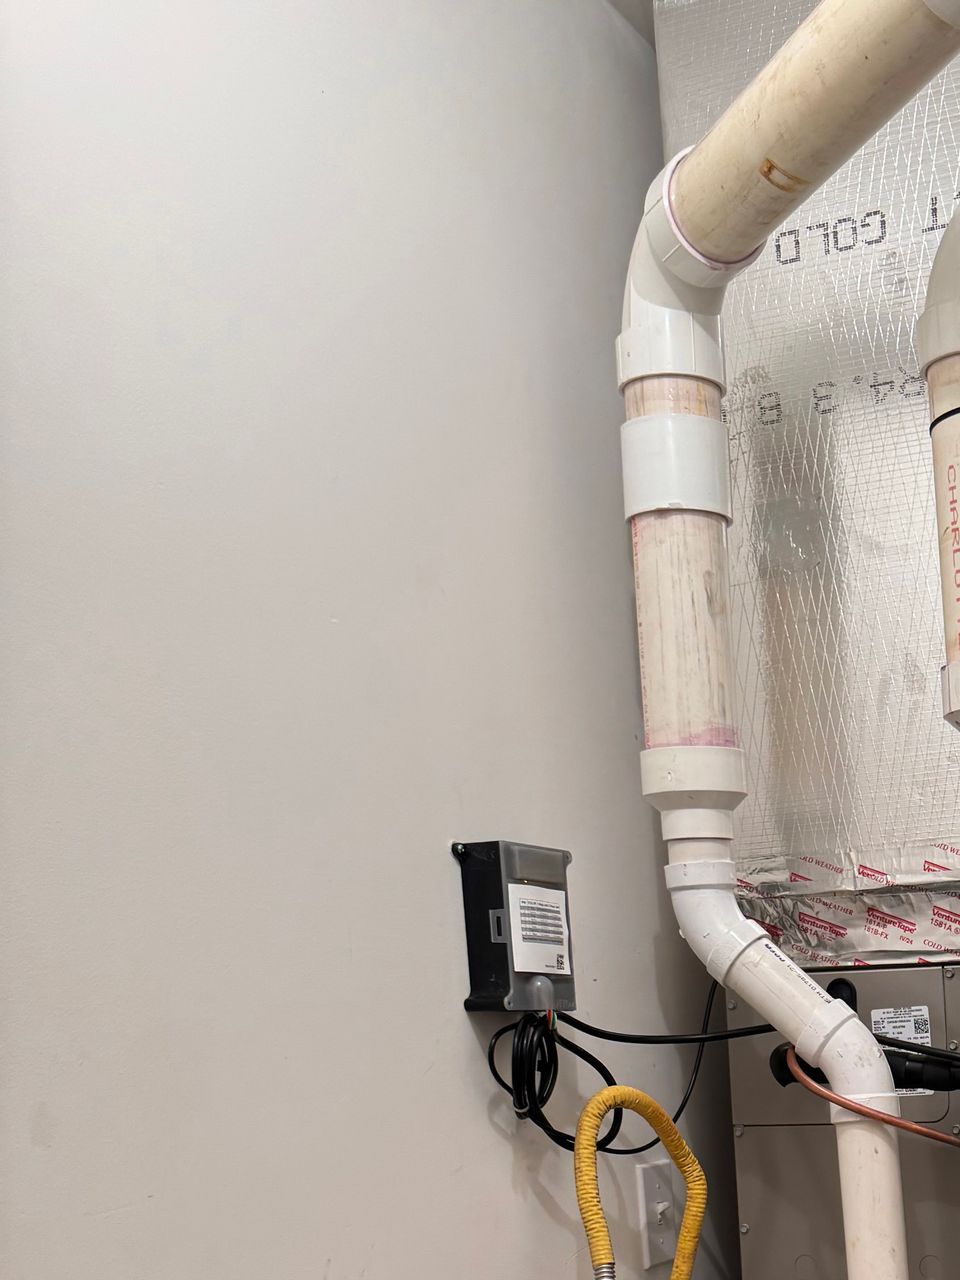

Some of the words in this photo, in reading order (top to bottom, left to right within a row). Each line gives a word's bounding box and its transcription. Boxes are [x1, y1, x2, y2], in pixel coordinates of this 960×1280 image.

[773, 210, 886, 266] GOLD
[814, 859, 844, 875] WEATHER
[822, 900, 854, 915] WEATHER
[930, 917, 953, 932] 1581A
[923, 939, 943, 950] COLD
[791, 943, 810, 955] COLD
[809, 951, 840, 967] WEATHER
